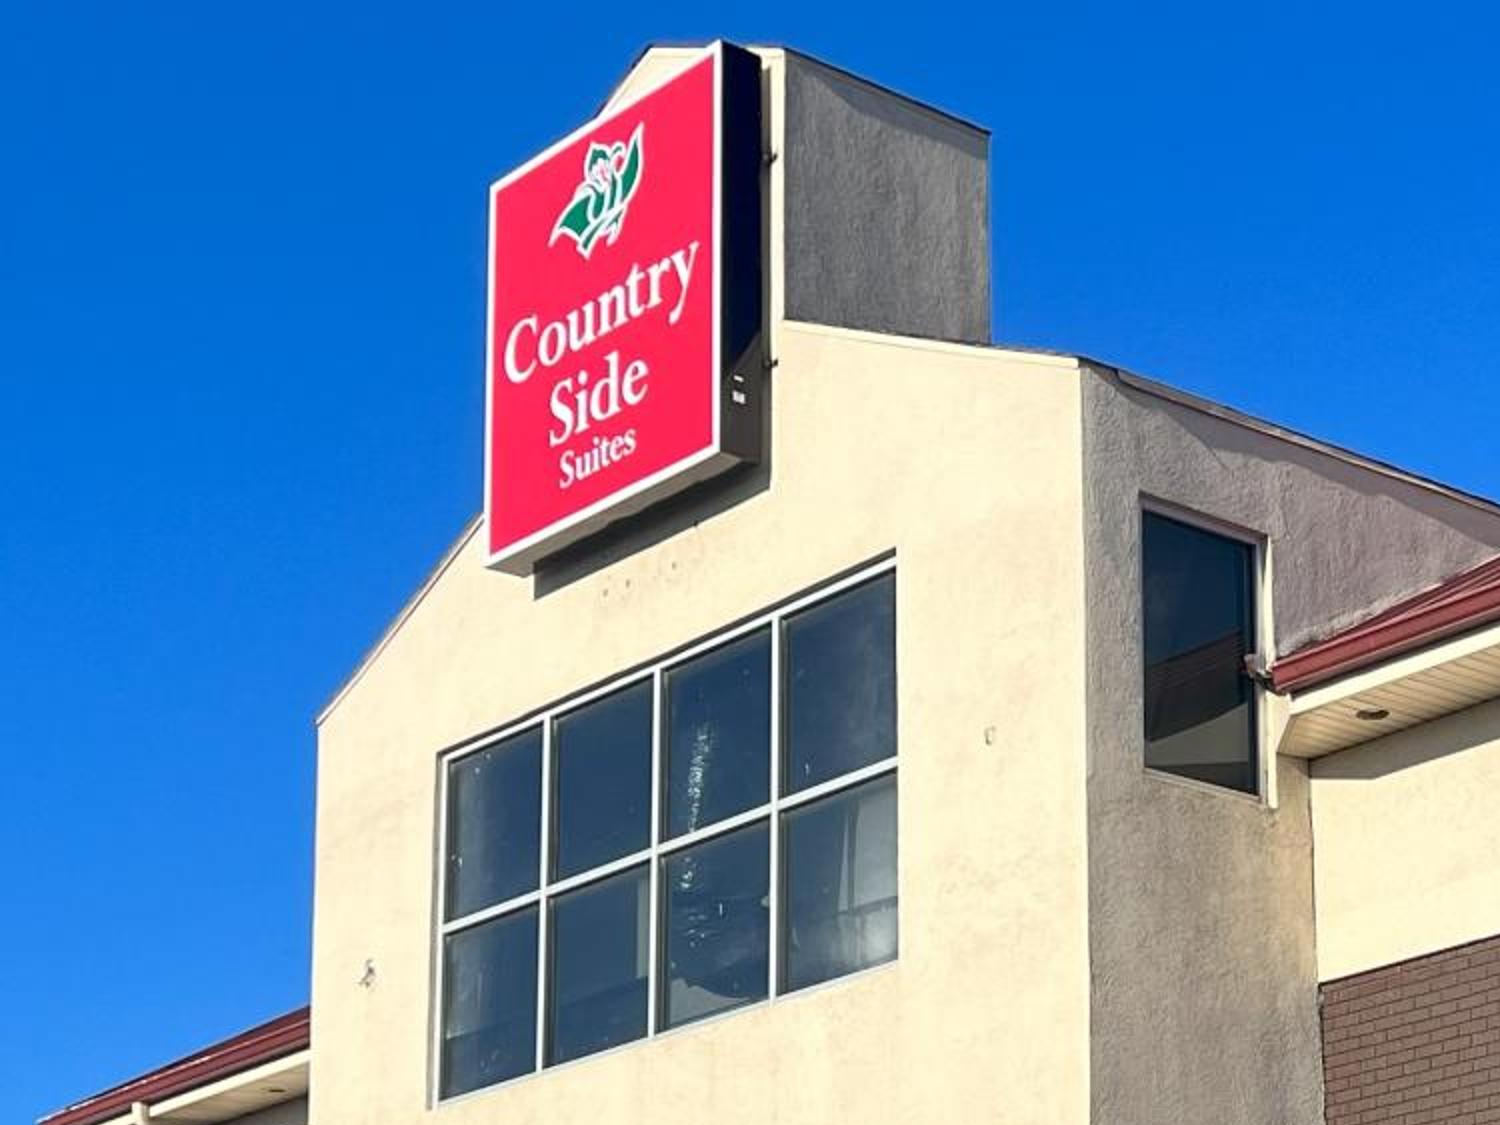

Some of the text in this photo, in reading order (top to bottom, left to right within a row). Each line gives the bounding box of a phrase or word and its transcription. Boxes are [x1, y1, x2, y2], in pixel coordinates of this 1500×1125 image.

[503, 240, 700, 384] Country
[549, 350, 650, 447] Side
[559, 427, 637, 489] Suites
